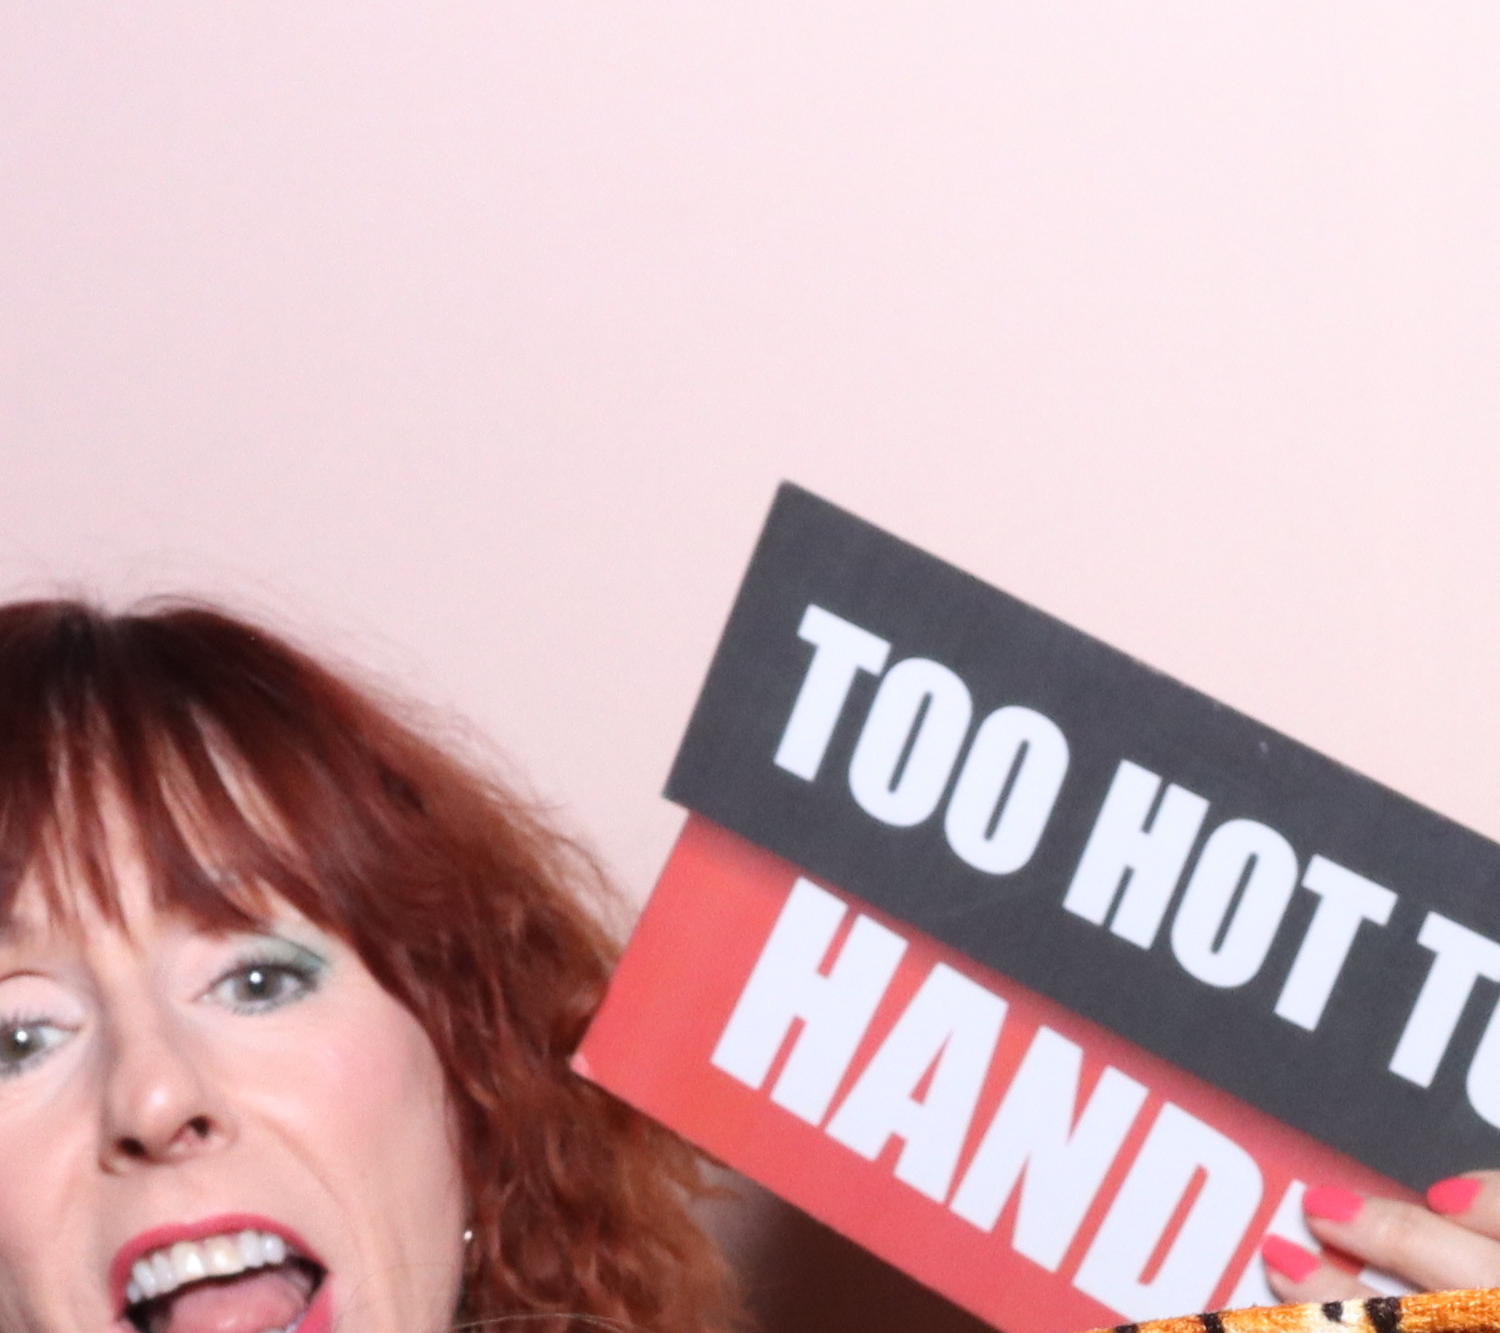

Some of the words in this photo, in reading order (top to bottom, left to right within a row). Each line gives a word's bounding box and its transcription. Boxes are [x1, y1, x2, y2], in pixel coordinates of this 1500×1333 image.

[773, 603, 1071, 875] TOO
[1062, 757, 1398, 1032] HOT
[709, 876, 1415, 1323] HAND
